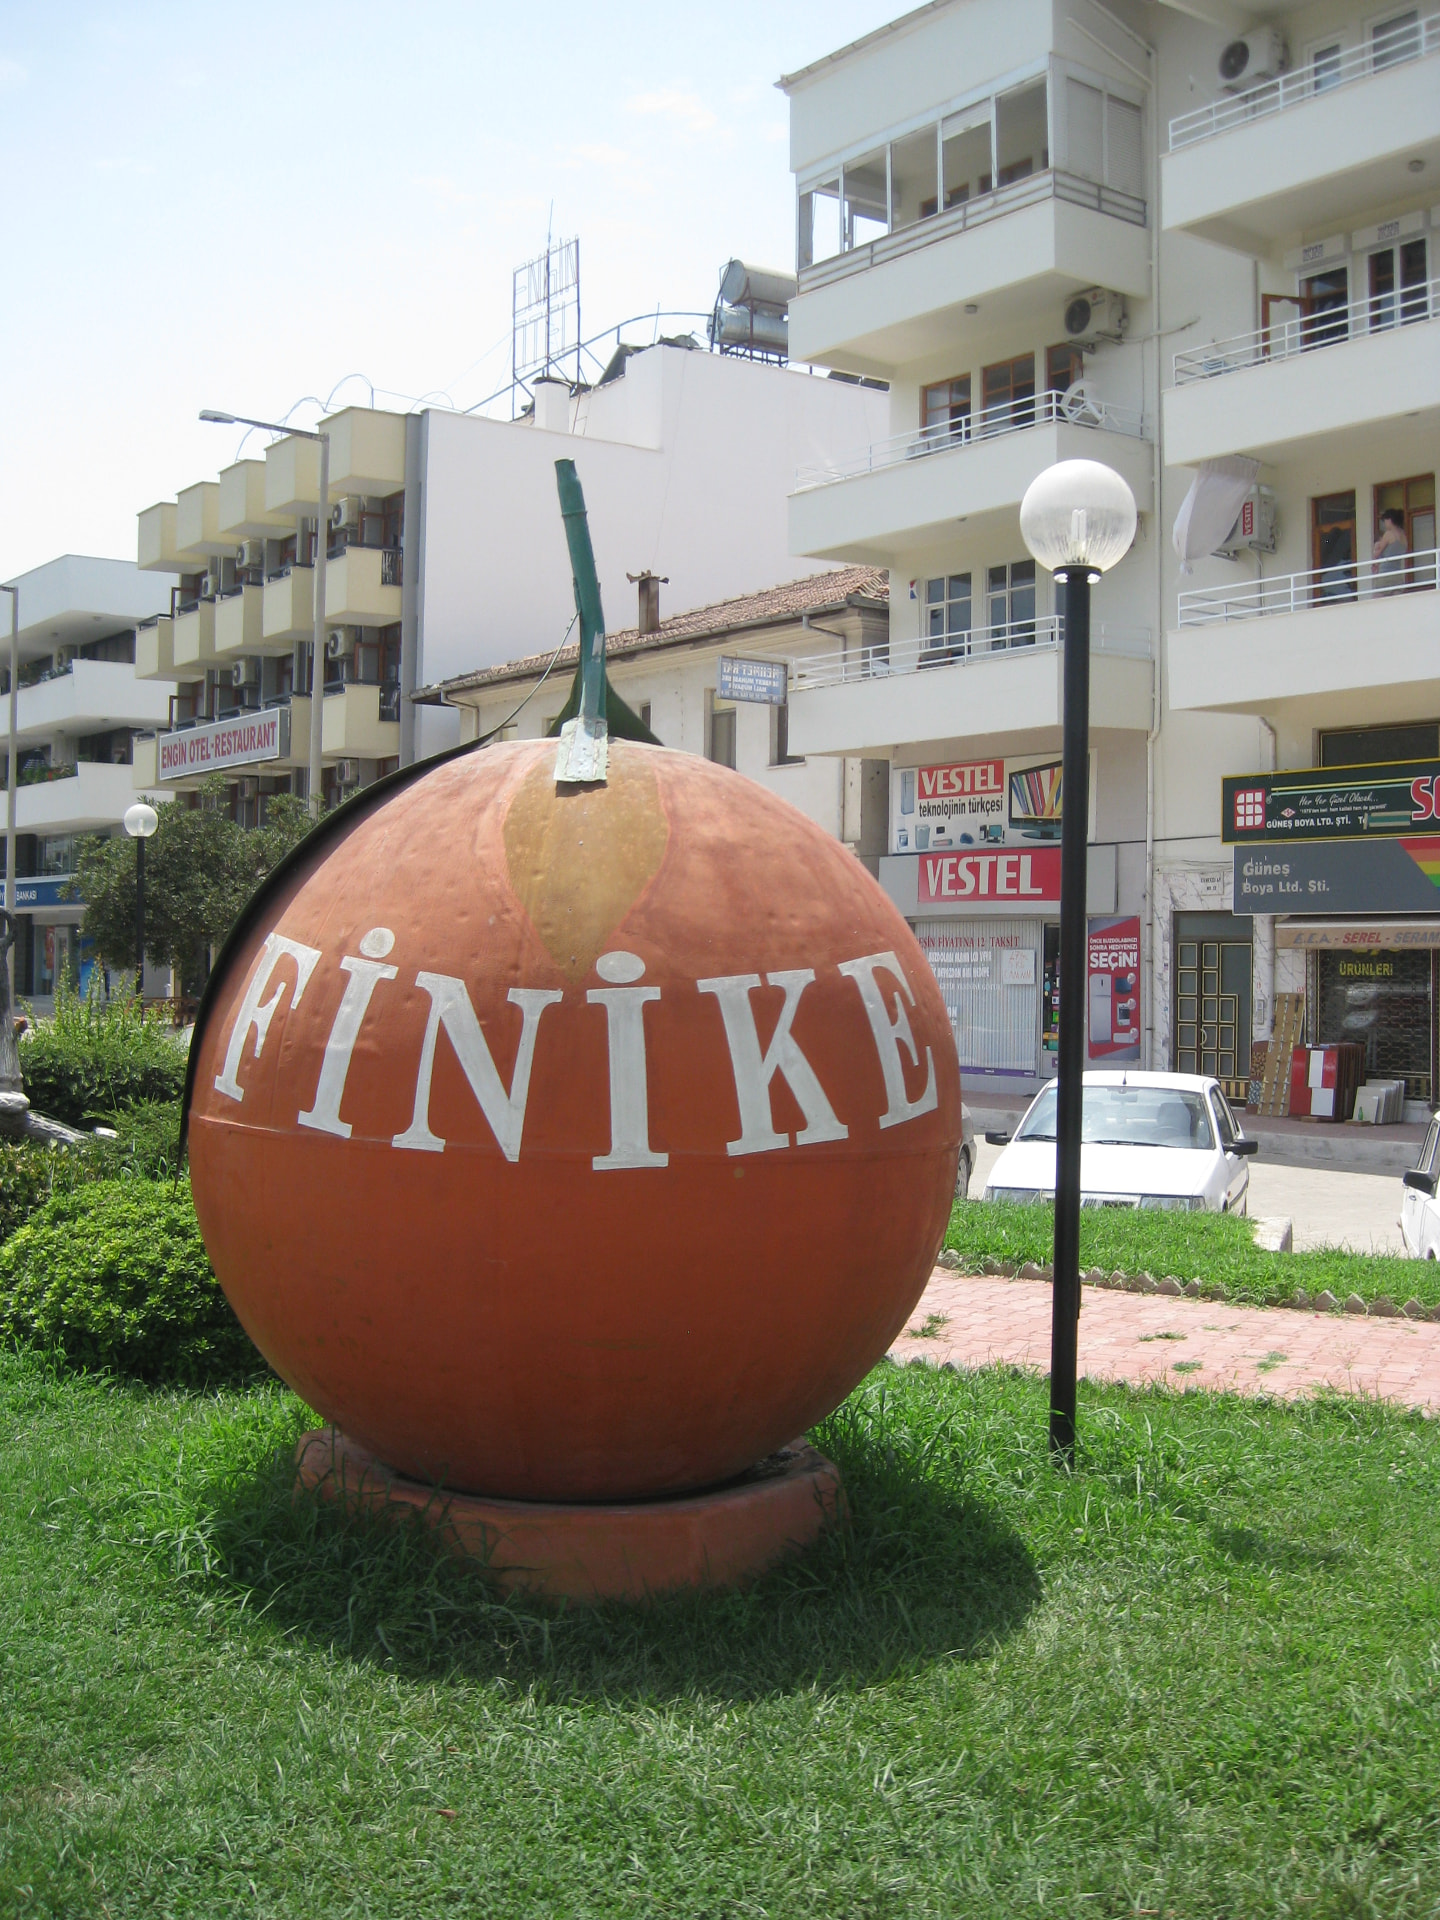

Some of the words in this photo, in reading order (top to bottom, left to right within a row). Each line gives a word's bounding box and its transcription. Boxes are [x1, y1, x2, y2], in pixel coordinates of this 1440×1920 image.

[161, 738, 187, 768] ENGİN
[921, 764, 1002, 796] VESTEL
[918, 798, 966, 819] teknolojinin
[968, 795, 1003, 817] türkçesi
[1266, 818, 1293, 829] GÜNEŞ
[1295, 817, 1316, 827] BOYA
[1317, 817, 1334, 826] LTD.
[1336, 814, 1351, 827] ŞTİ.
[926, 855, 1043, 897] VESTEL
[1243, 862, 1290, 877] Güneş
[1243, 881, 1273, 896] Boya
[1278, 880, 1303, 893] Ltd.
[1308, 879, 1330, 894] Şti.
[918, 935, 936, 949] EŞİN
[977, 936, 986, 947] 12
[1342, 932, 1382, 944] SEREL
[1089, 951, 1138, 971] SEÇİN!
[1339, 961, 1393, 976] ÜRÜNLERİ
[214, 927, 938, 1171] FİNİKE
